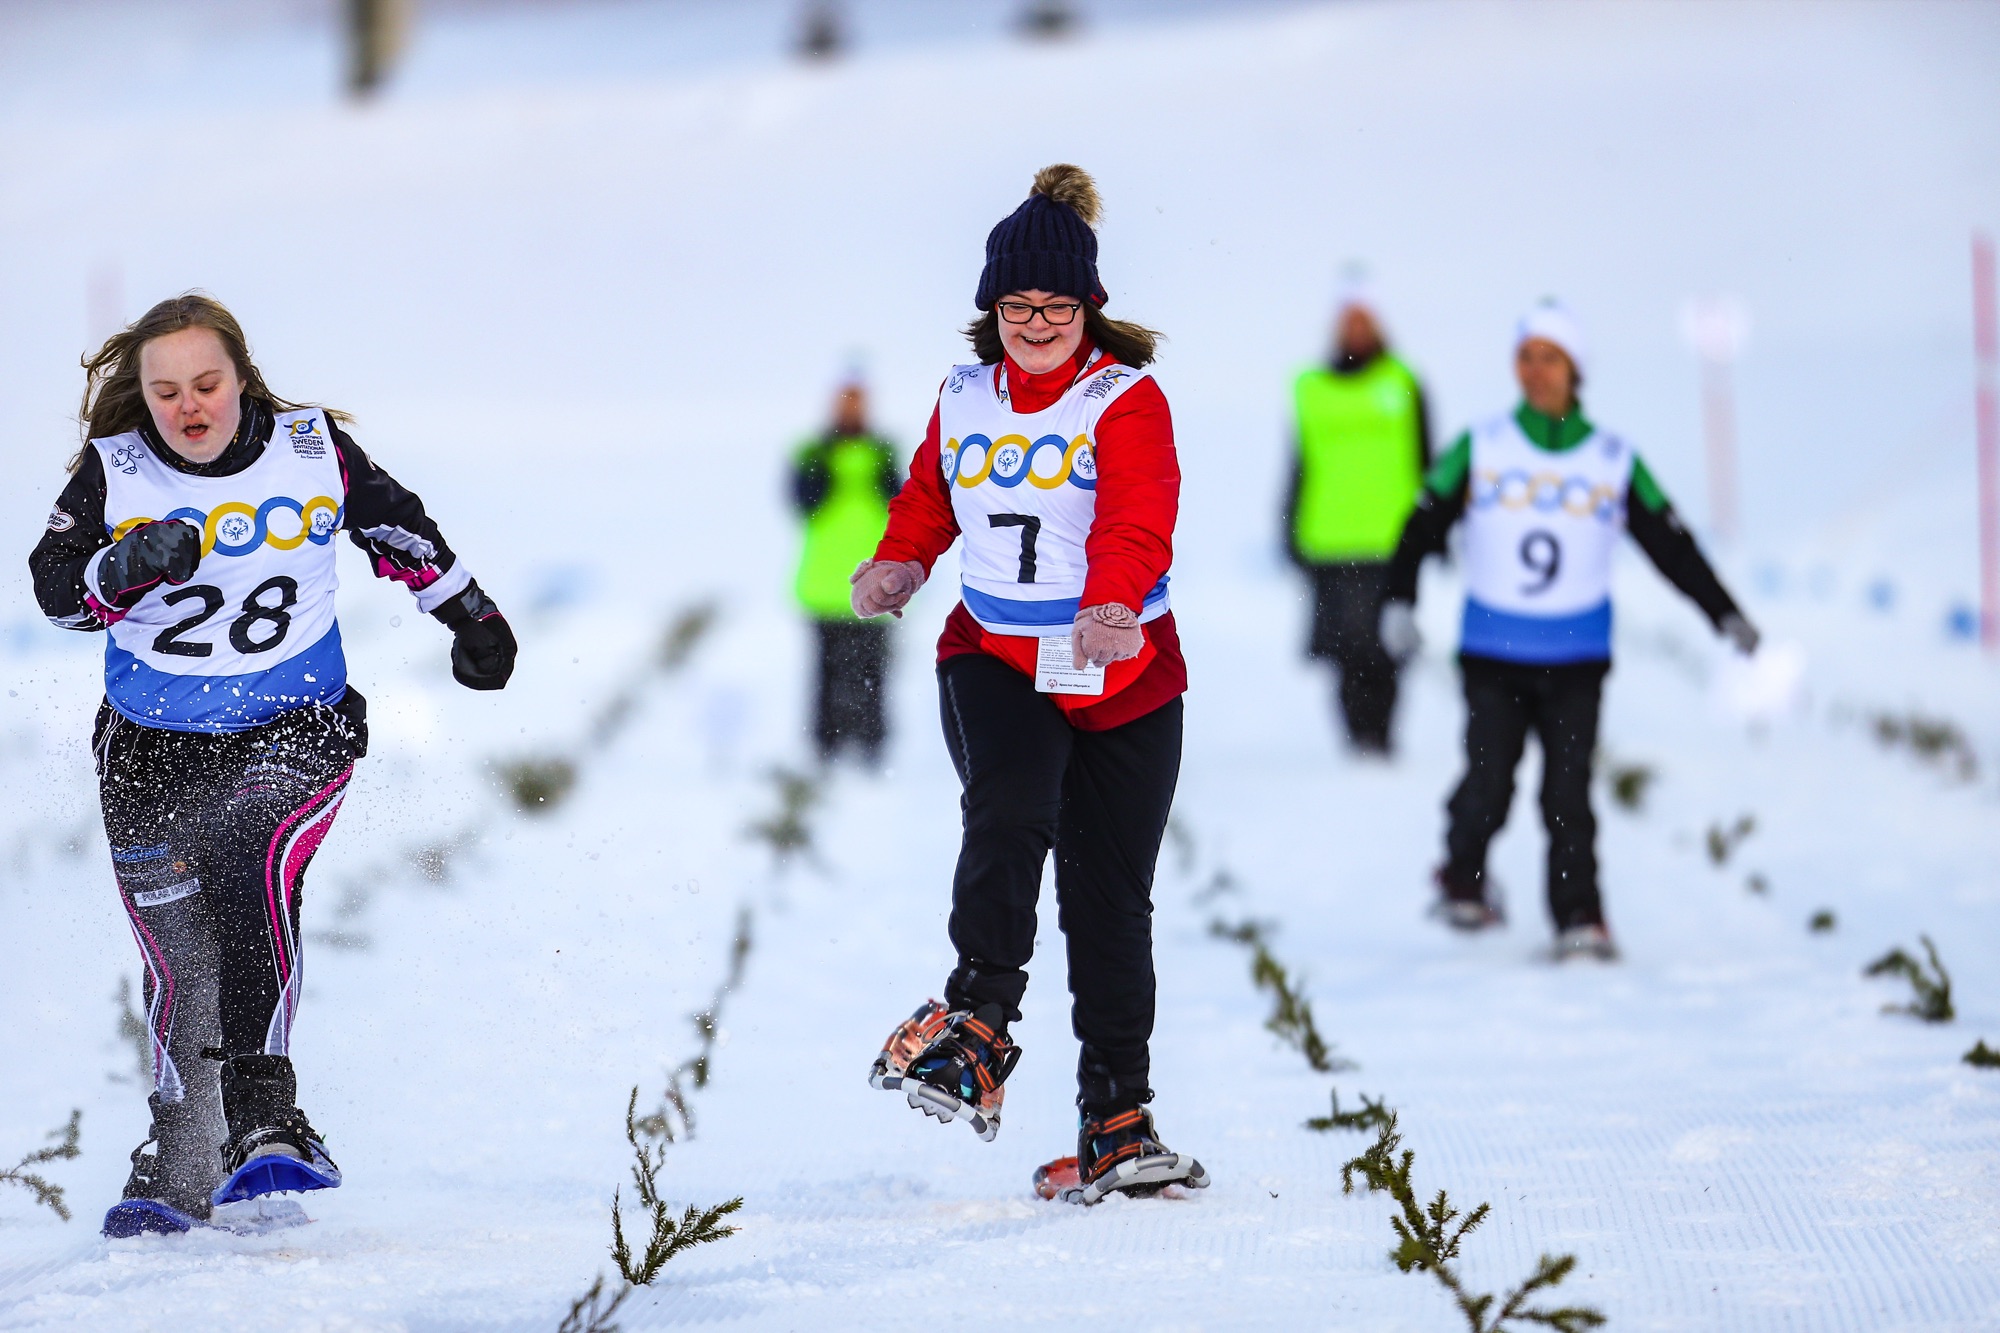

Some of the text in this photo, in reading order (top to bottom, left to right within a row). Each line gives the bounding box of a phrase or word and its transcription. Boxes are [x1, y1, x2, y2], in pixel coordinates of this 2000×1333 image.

[987, 513, 1042, 584] 7
[1517, 527, 1561, 598] 9
[152, 575, 298, 657] 28
